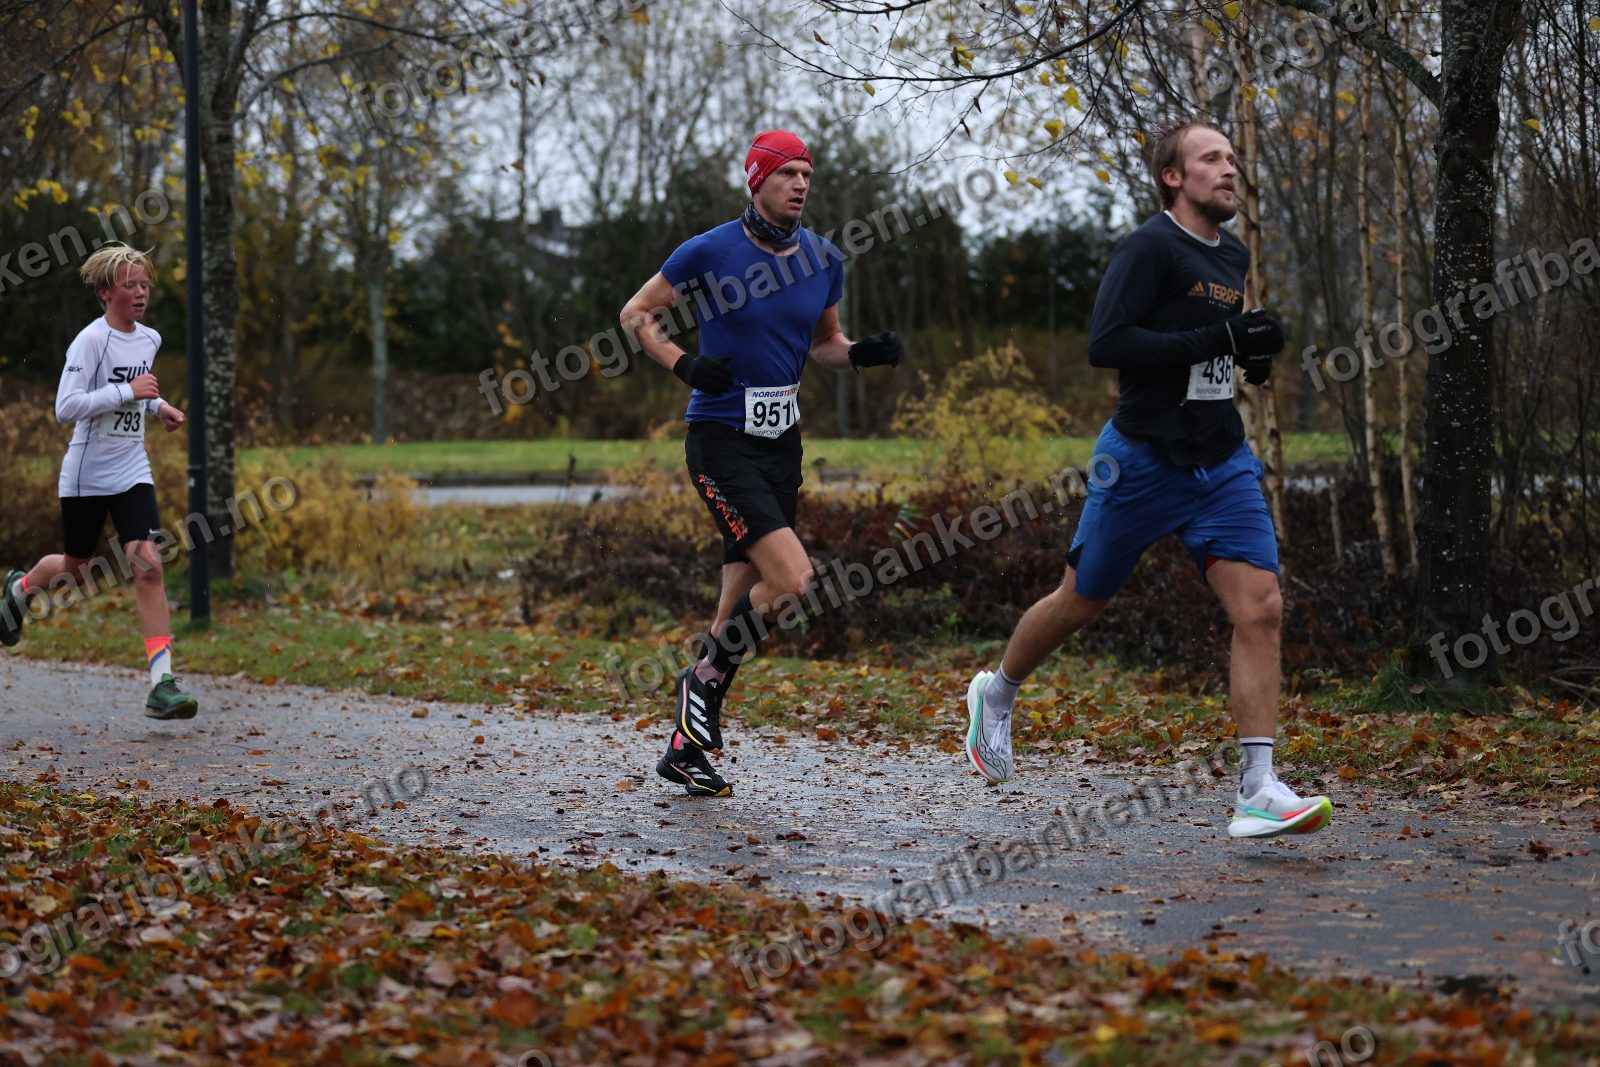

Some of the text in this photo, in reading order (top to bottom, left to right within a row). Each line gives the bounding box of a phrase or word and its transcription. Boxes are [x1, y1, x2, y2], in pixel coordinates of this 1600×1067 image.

[1203, 355, 1231, 385] 436
[113, 411, 141, 432] 793
[752, 401, 791, 428] 951
